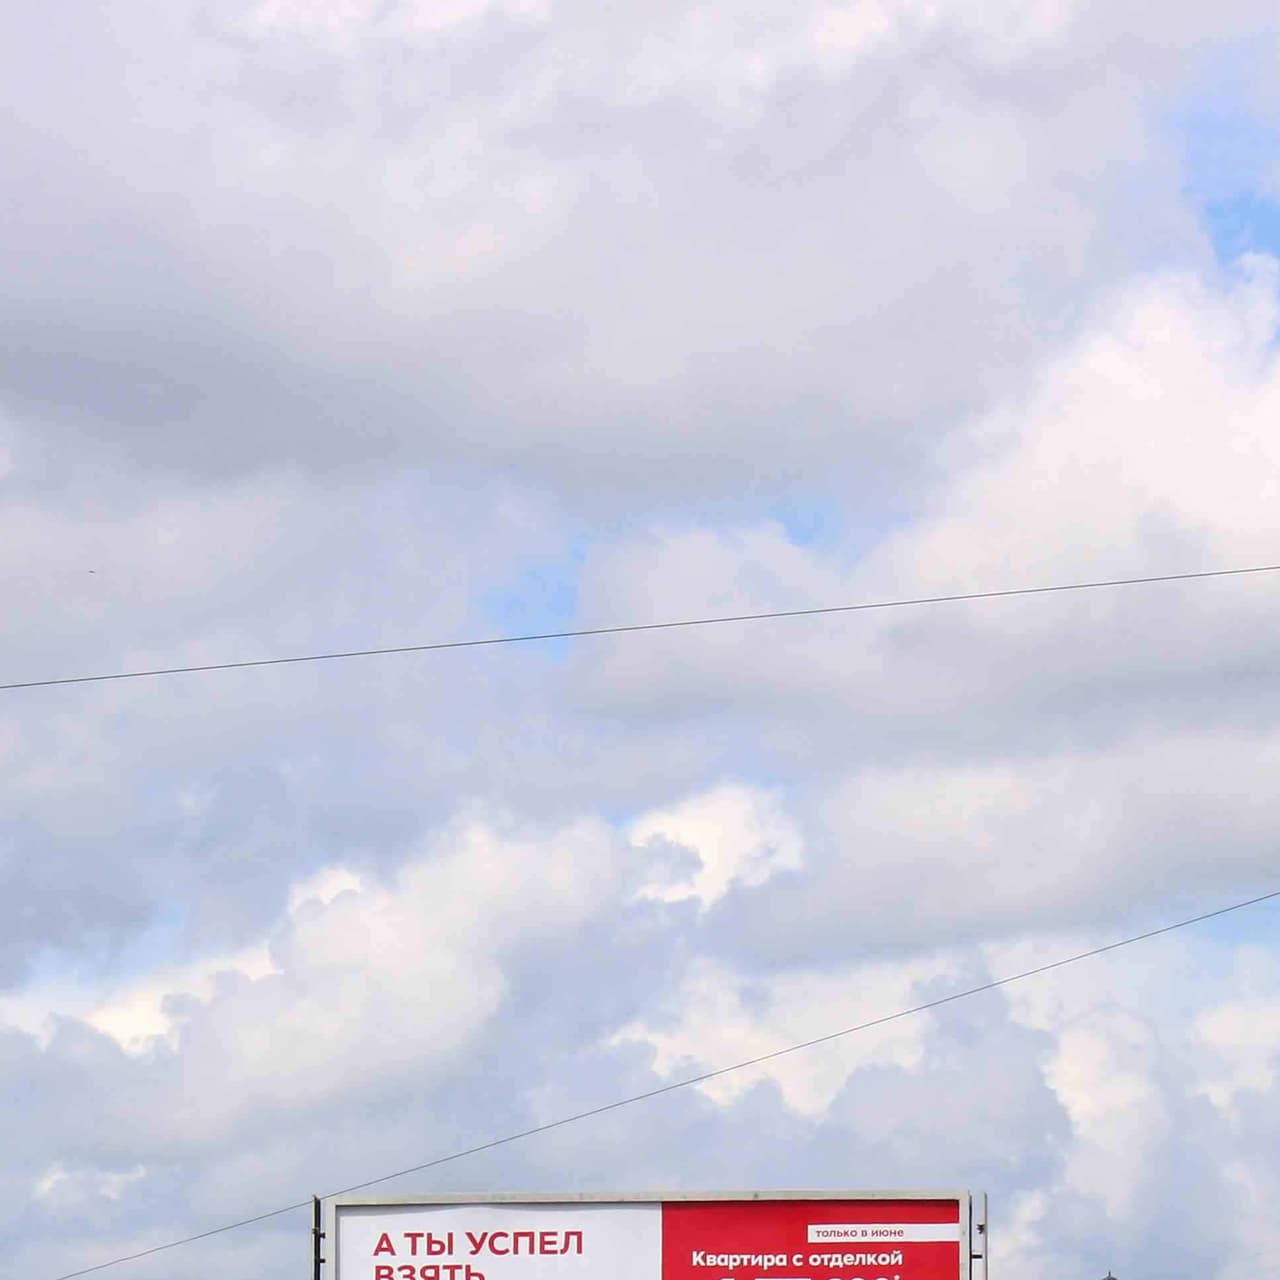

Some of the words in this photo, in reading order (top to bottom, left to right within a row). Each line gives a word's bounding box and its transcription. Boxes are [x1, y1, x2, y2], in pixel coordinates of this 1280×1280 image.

[815, 1228, 857, 1238] только
[861, 1229, 868, 1237] в
[871, 1228, 904, 1238] июне
[373, 1232, 396, 1256] А
[404, 1232, 454, 1256] ТЫ
[465, 1231, 583, 1255] УСПЕЛ
[692, 1251, 787, 1270] Квартира
[792, 1254, 803, 1265] с
[808, 1250, 904, 1268] отделкой
